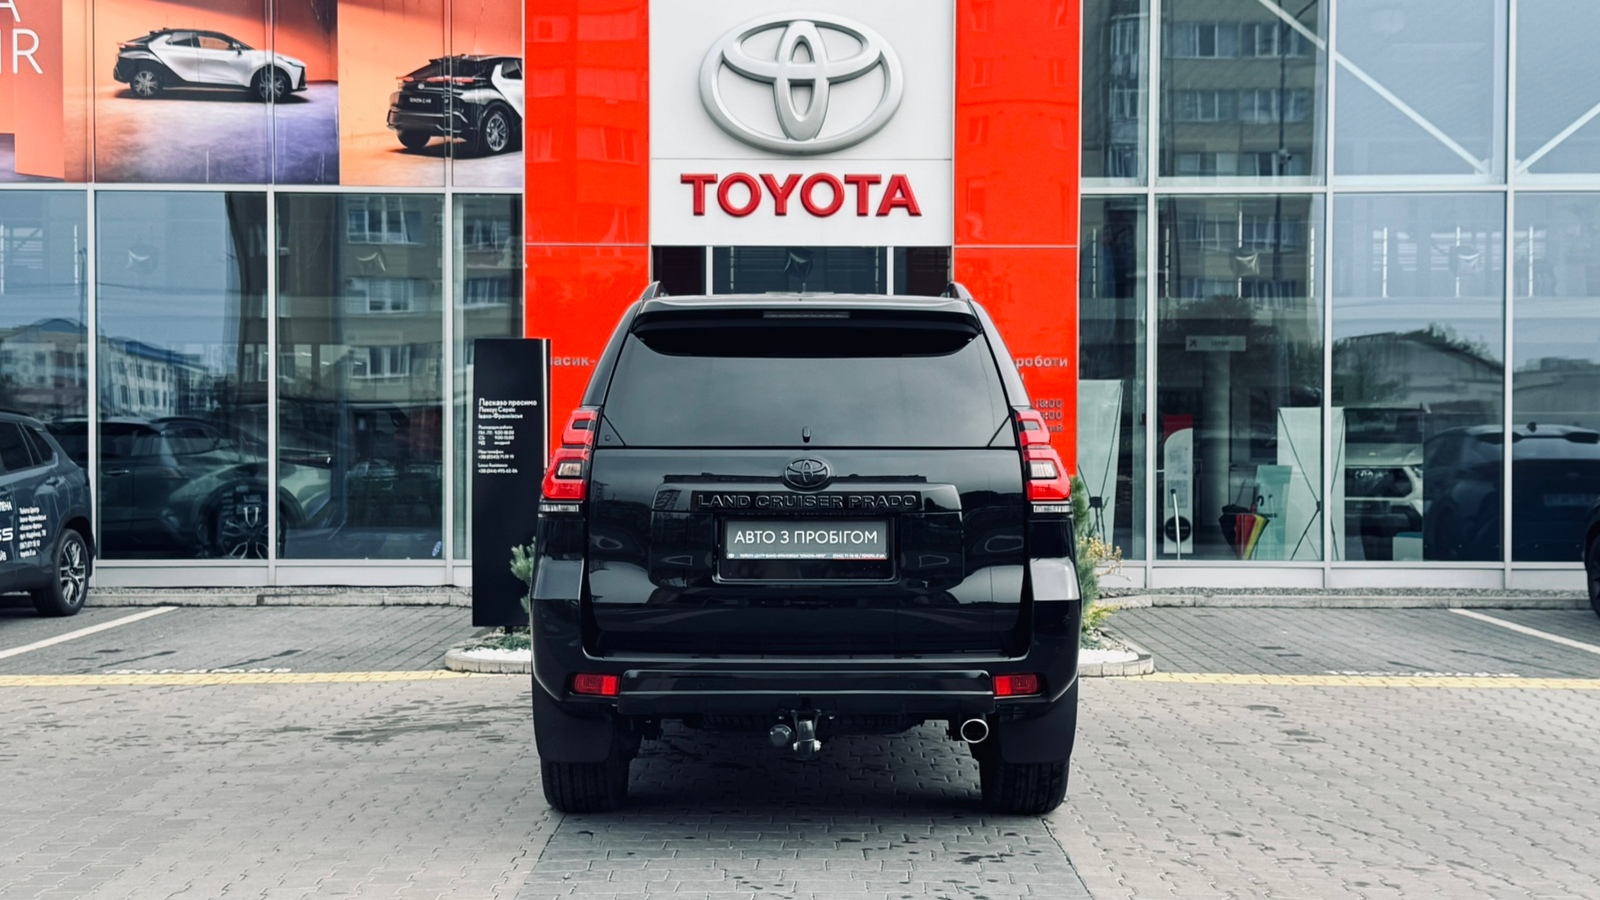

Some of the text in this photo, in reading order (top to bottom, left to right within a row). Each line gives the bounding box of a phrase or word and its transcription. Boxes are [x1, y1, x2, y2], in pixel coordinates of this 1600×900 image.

[680, 172, 922, 218] TOYOTA
[1016, 355, 1068, 369] роботи
[698, 494, 917, 508] LAND CRUISER PRADO
[734, 530, 776, 544] АВТО
[794, 530, 878, 544] ПРОБІГОМ
